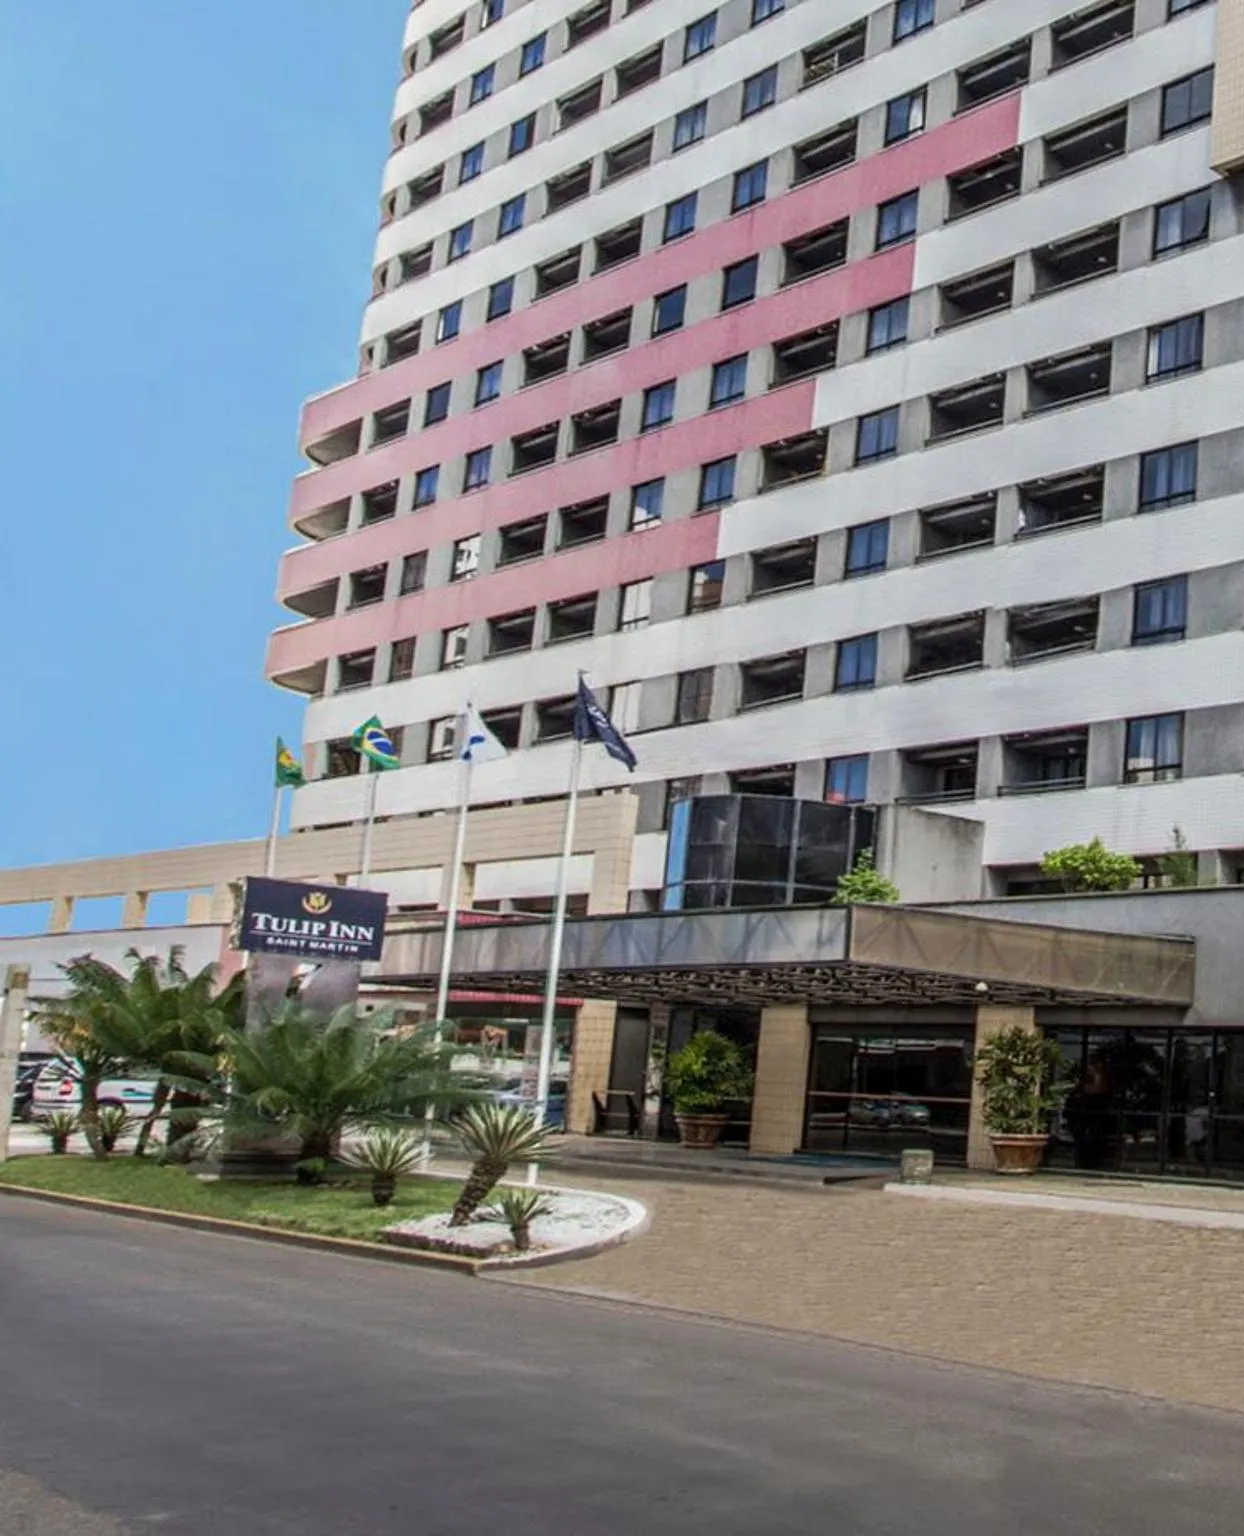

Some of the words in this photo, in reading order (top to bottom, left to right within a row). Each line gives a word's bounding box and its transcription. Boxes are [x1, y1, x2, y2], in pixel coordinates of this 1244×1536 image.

[251, 912, 327, 936] TULIP
[328, 920, 375, 941] INN
[266, 936, 306, 949] SAINT
[308, 941, 359, 953] MARTIN
